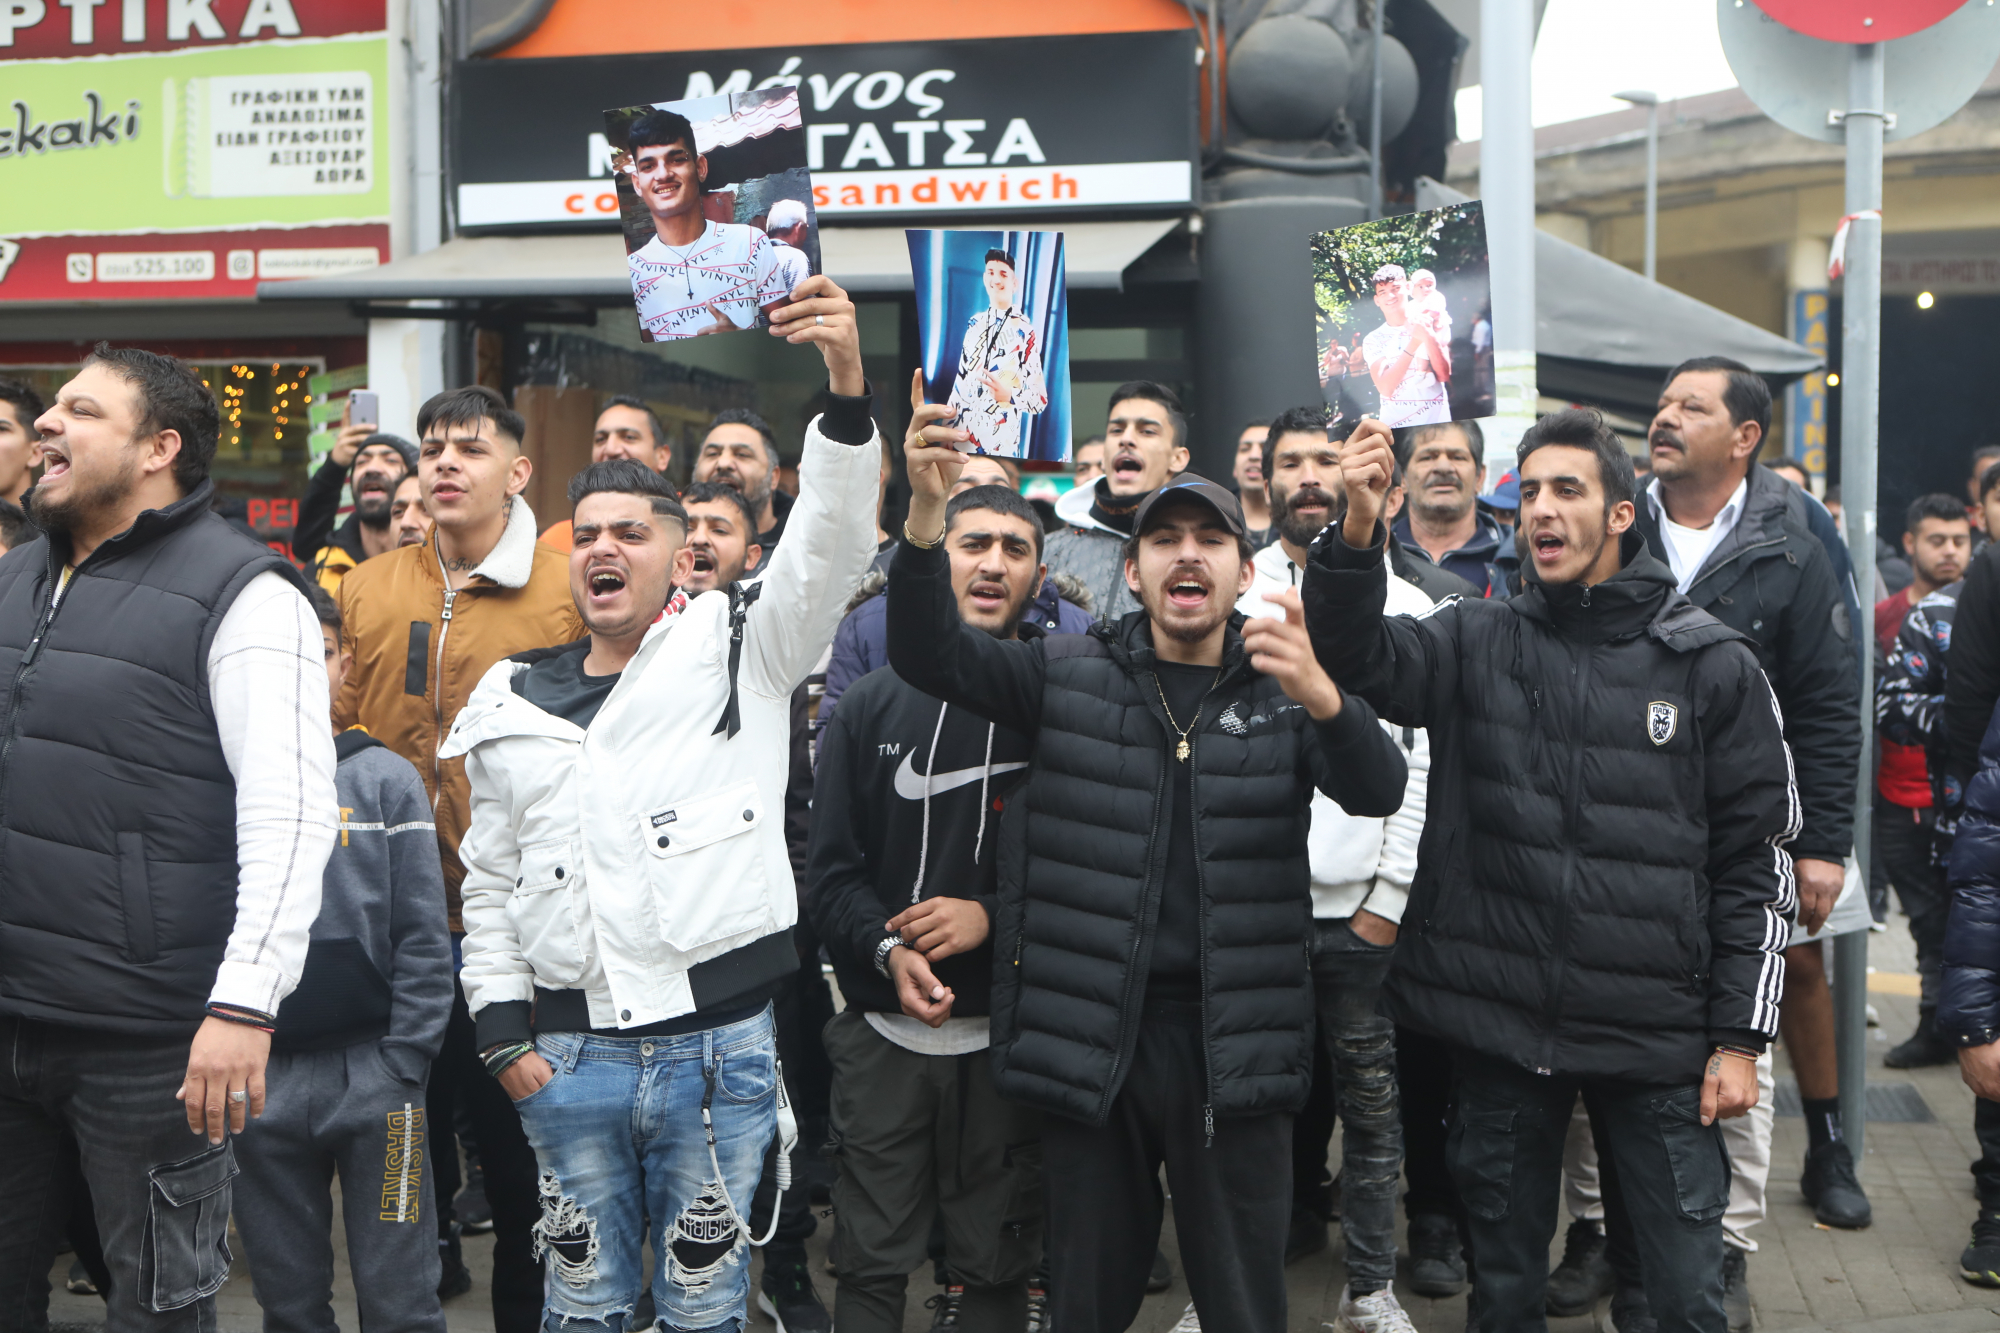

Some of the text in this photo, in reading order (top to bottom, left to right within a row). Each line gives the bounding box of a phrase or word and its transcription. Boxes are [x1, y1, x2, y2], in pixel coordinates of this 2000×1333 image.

[231, 88, 364, 106] ΓΡΑΦΙΚΗ ΥΛΗ
[251, 107, 365, 124] ΑΝΑΛΩΣΙΜΑ
[216, 129, 366, 147] ΕΙΔΗ ΓΡΑΦΕΙΟΥ
[269, 149, 366, 166] ΑΞΕΣΟΥΑΡ
[314, 168, 365, 184] ΔΩΡΑ
[812, 172, 1079, 206] sandwich
[132, 256, 206, 276] 525.100
[645, 264, 685, 275] VINYL
[700, 269, 740, 288] VINYL
[677, 306, 707, 319] VINY
[1803, 294, 1830, 473] PAKING
[878, 743, 900, 756] TM
[379, 1108, 425, 1223] BASKET
